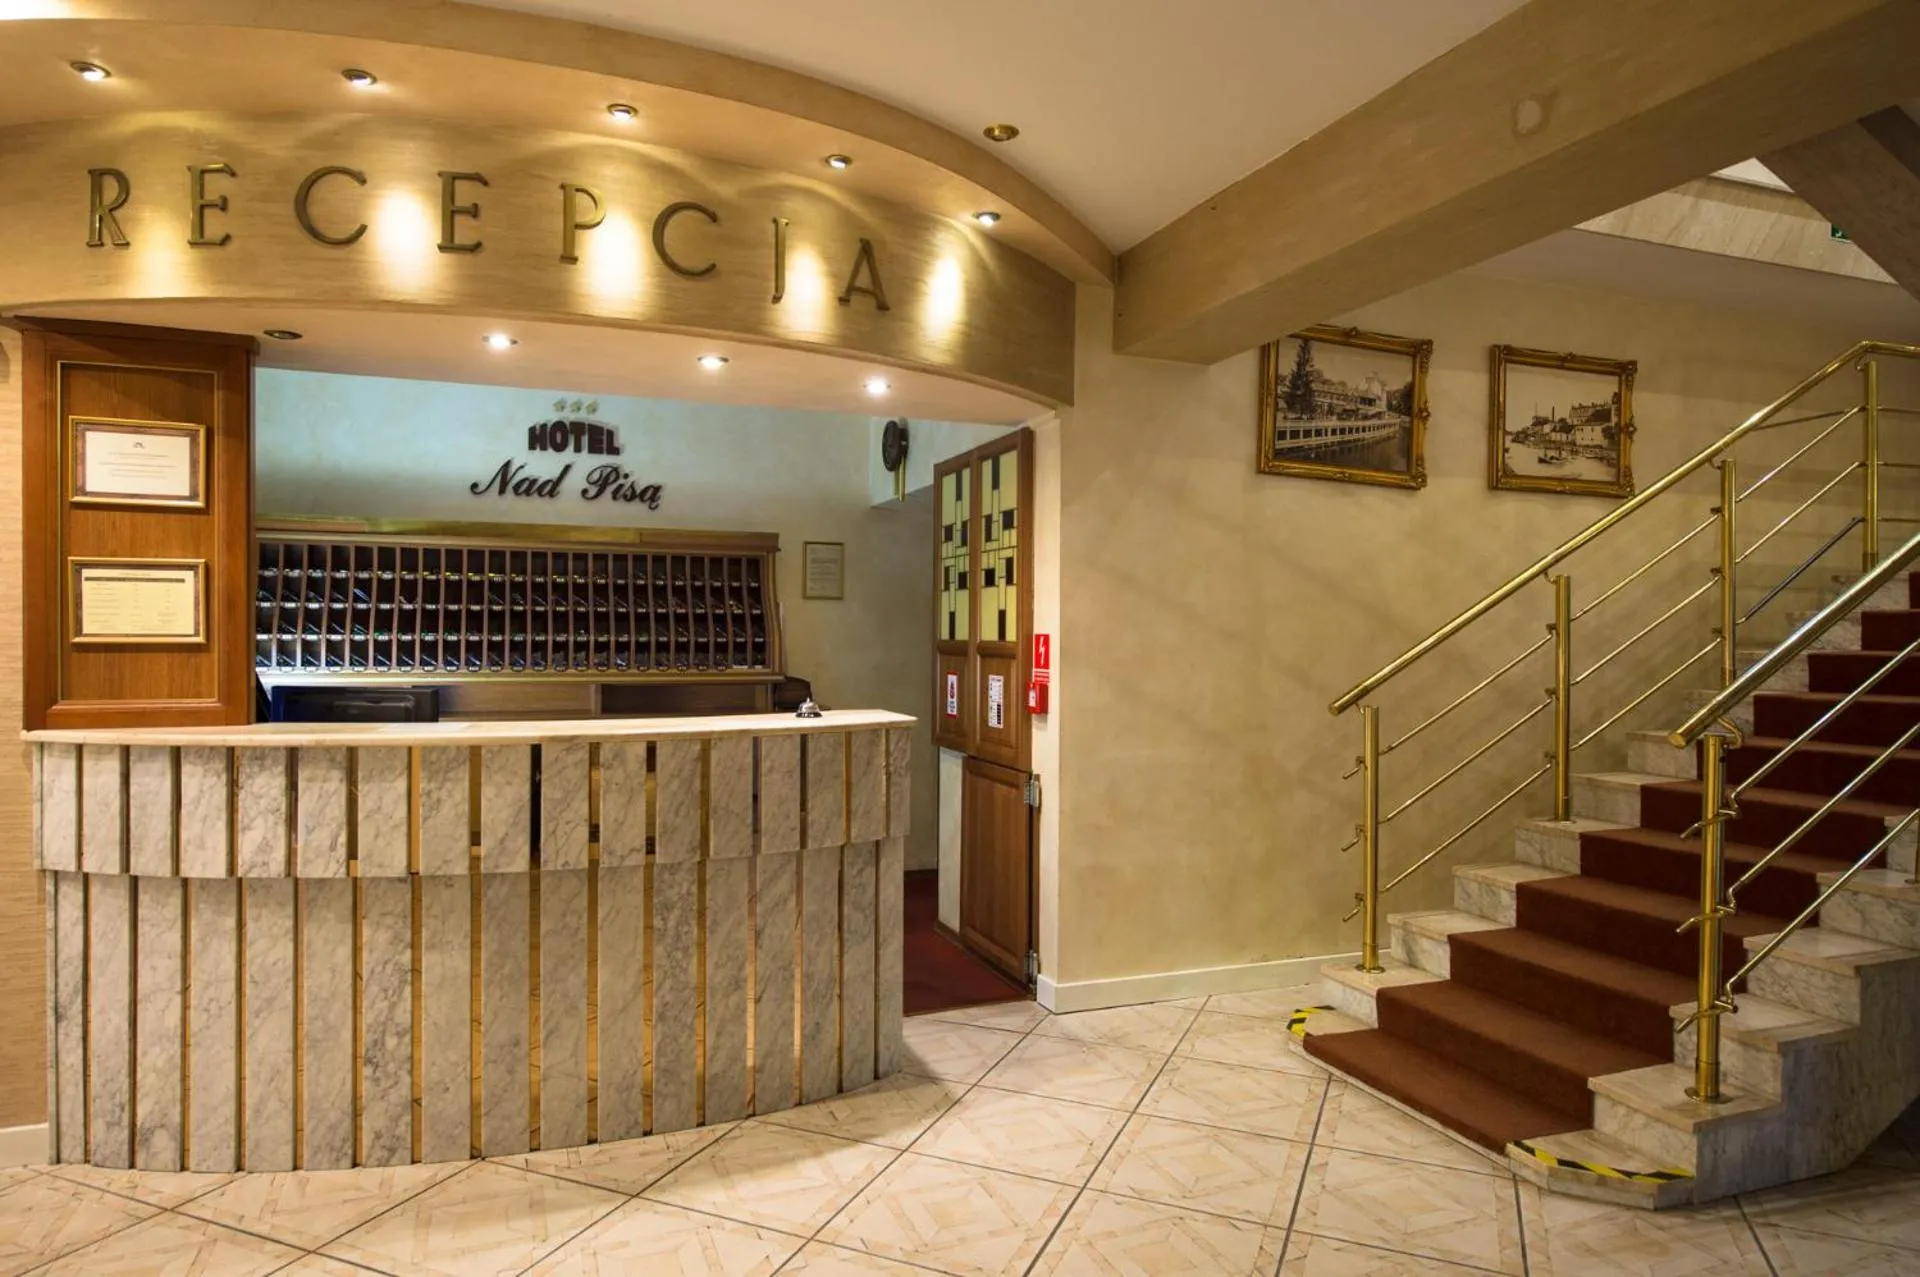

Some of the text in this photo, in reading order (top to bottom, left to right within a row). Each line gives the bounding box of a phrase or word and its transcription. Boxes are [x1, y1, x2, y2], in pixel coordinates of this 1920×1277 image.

[86, 163, 890, 311] RECEPCJA
[528, 420, 620, 456] HOTEL
[470, 457, 662, 511] Nad Pisą
